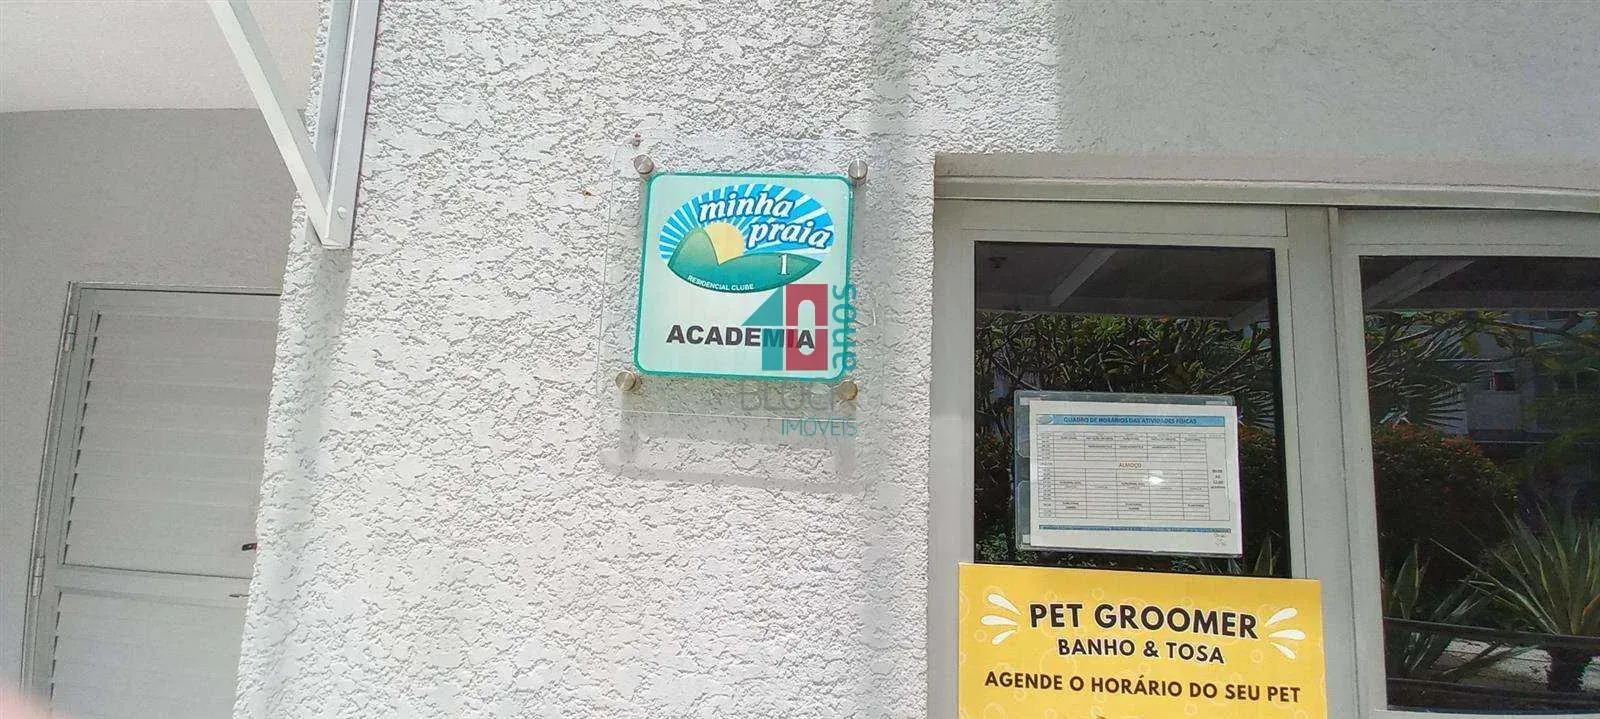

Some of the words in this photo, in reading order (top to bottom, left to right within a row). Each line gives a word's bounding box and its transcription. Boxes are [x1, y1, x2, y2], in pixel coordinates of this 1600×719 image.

[699, 191, 795, 222] minha
[746, 219, 833, 250] praia
[687, 274, 730, 291] RESIDENCIAL
[731, 283, 755, 292] CLUBE
[666, 324, 815, 349] ACADEMIA
[1029, 603, 1083, 629] PET
[1094, 604, 1259, 639] GROOMER
[1058, 639, 1135, 657] BANHO
[1143, 641, 1160, 658] &
[1166, 642, 1225, 664] TOSA
[985, 671, 1063, 691] AGENDE
[1070, 676, 1084, 691] O
[1091, 675, 1183, 697] HORÁRIO
[1189, 682, 1218, 699] DO
[1225, 684, 1260, 701] SEU
[1267, 686, 1301, 703] PET
